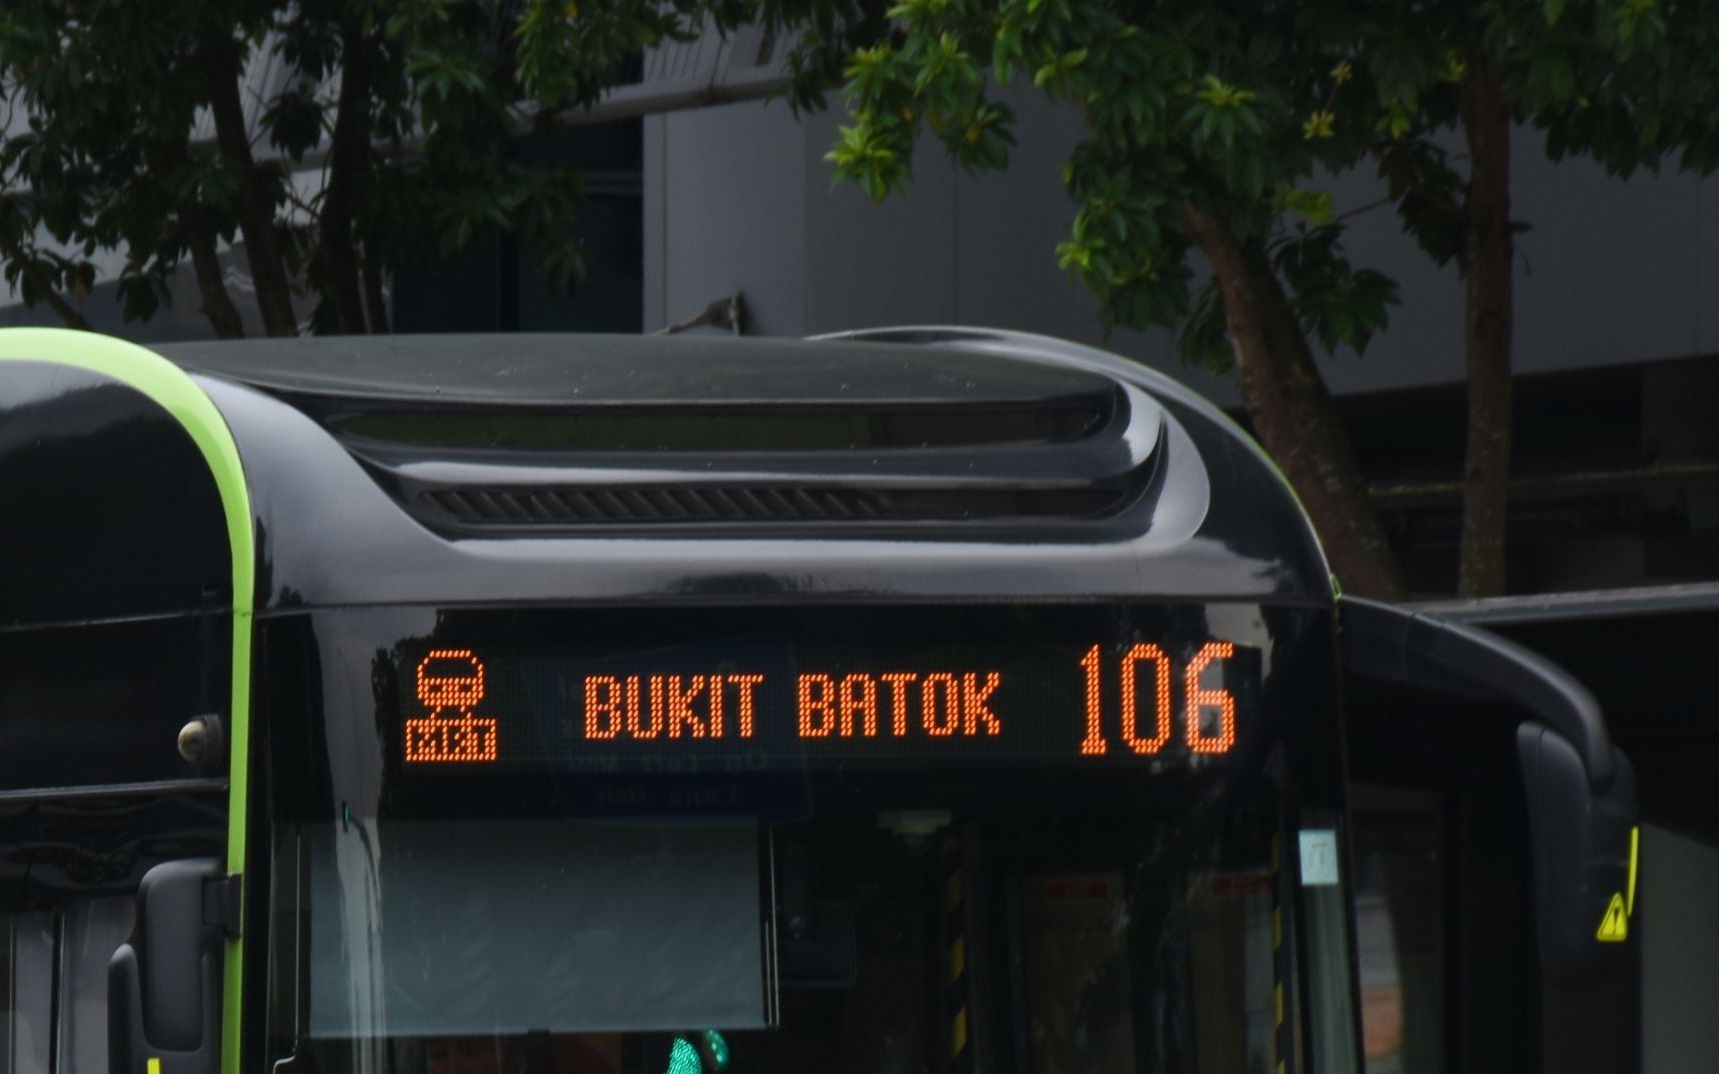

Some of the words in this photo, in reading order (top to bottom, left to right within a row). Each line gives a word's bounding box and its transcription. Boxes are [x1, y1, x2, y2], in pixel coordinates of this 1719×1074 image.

[585, 674, 764, 739] BUKIT
[798, 672, 1000, 737] BATOK
[1080, 642, 1235, 755] 106
